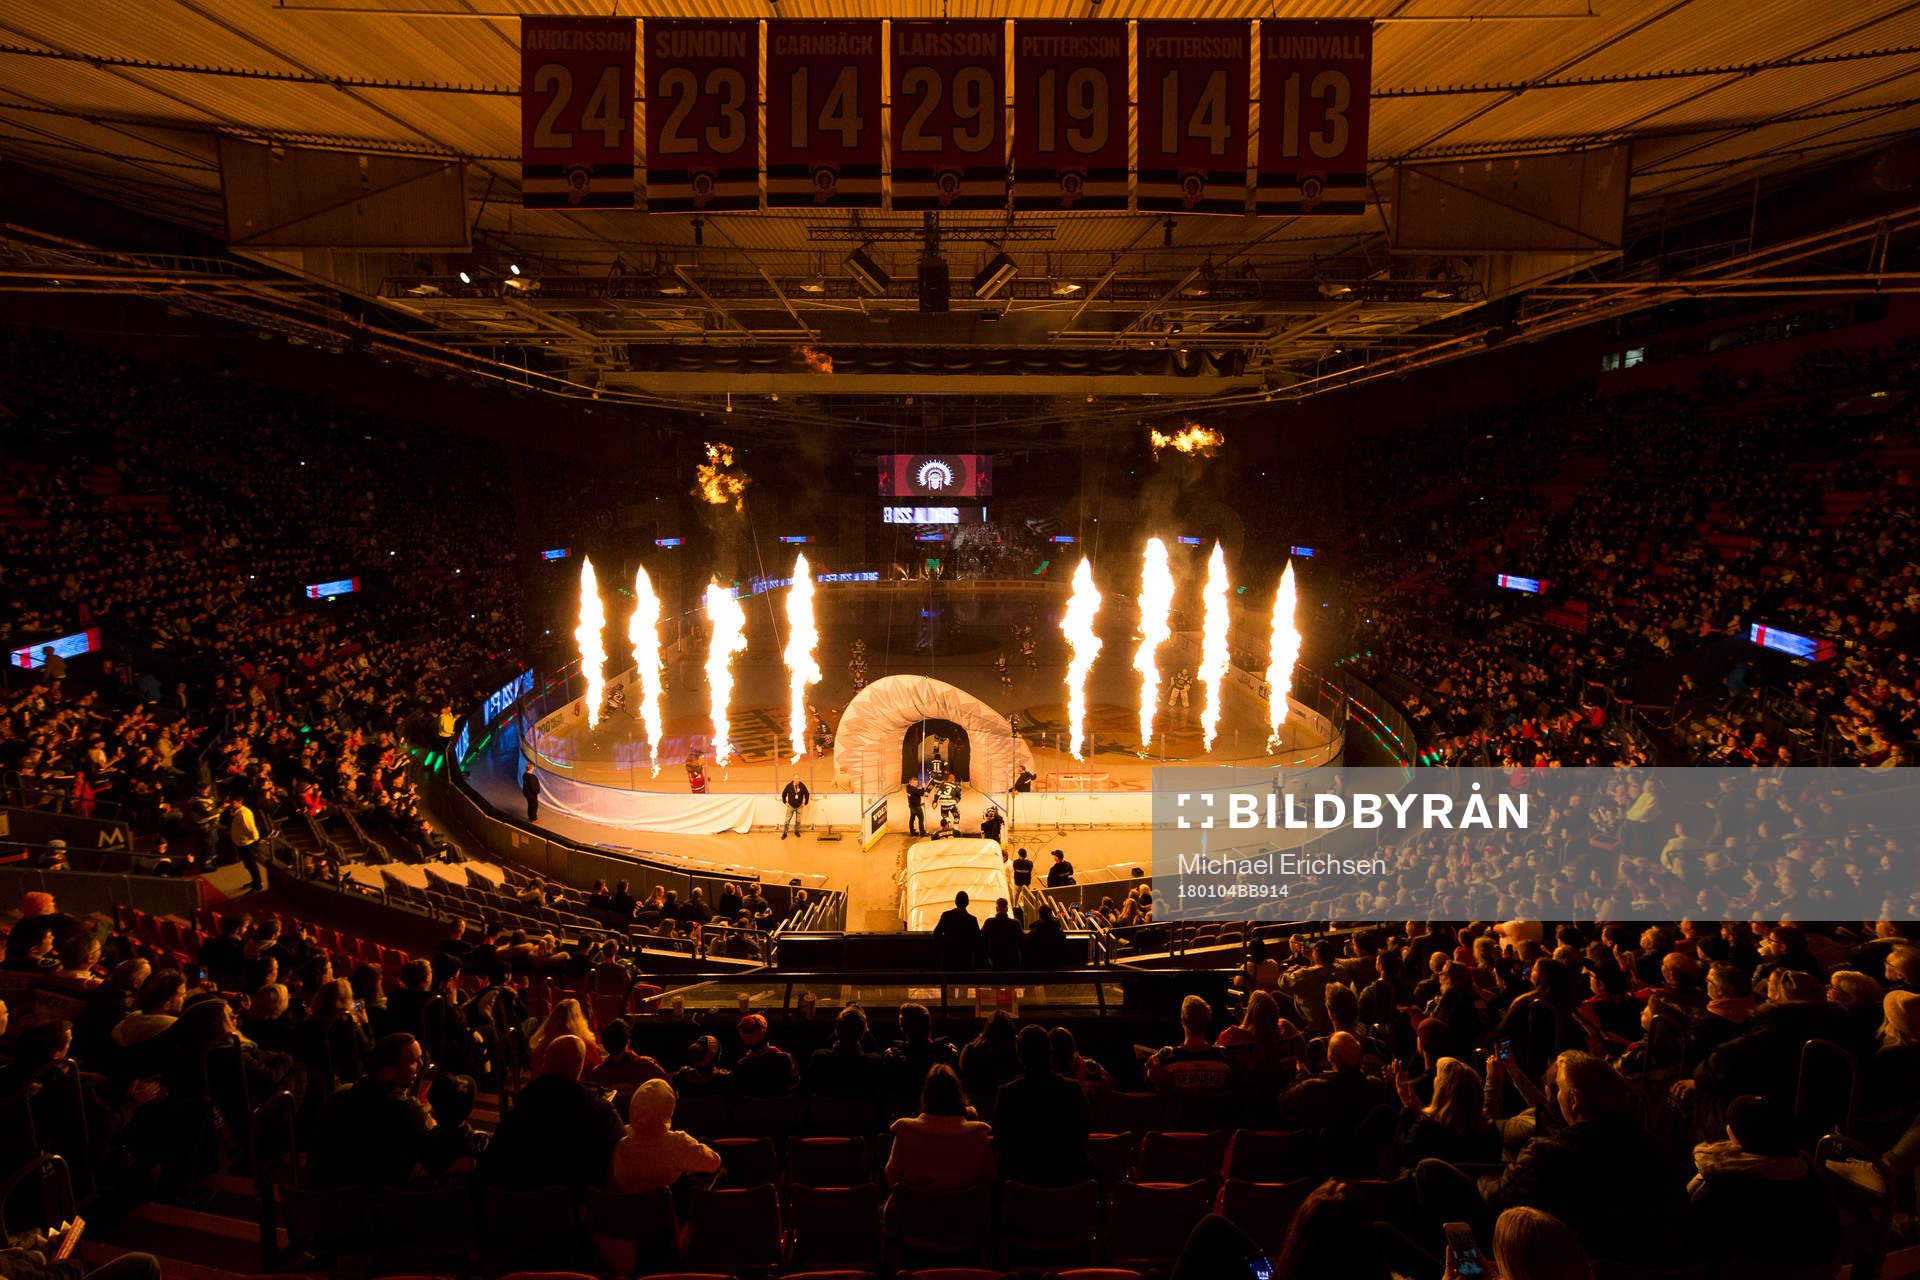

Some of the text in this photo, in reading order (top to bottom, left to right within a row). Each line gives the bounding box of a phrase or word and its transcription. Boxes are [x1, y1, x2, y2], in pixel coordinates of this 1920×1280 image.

[527, 29, 632, 52] ANDERSSON
[655, 30, 748, 59] SUNDIN
[775, 32, 873, 56] CARNBÄCK
[898, 32, 998, 57] LARSSON
[1022, 36, 1120, 58] PETTERSSON
[1145, 36, 1244, 60] PETTERSSON
[1266, 36, 1365, 60] LUNDVALL
[532, 63, 627, 149] 24
[657, 66, 748, 154] 23
[789, 65, 864, 149] 14
[899, 66, 996, 153] 29
[1037, 67, 1110, 154] 19
[1160, 69, 1232, 156] 14
[1281, 70, 1351, 159] 13
[943, 786, 952, 796] 3
